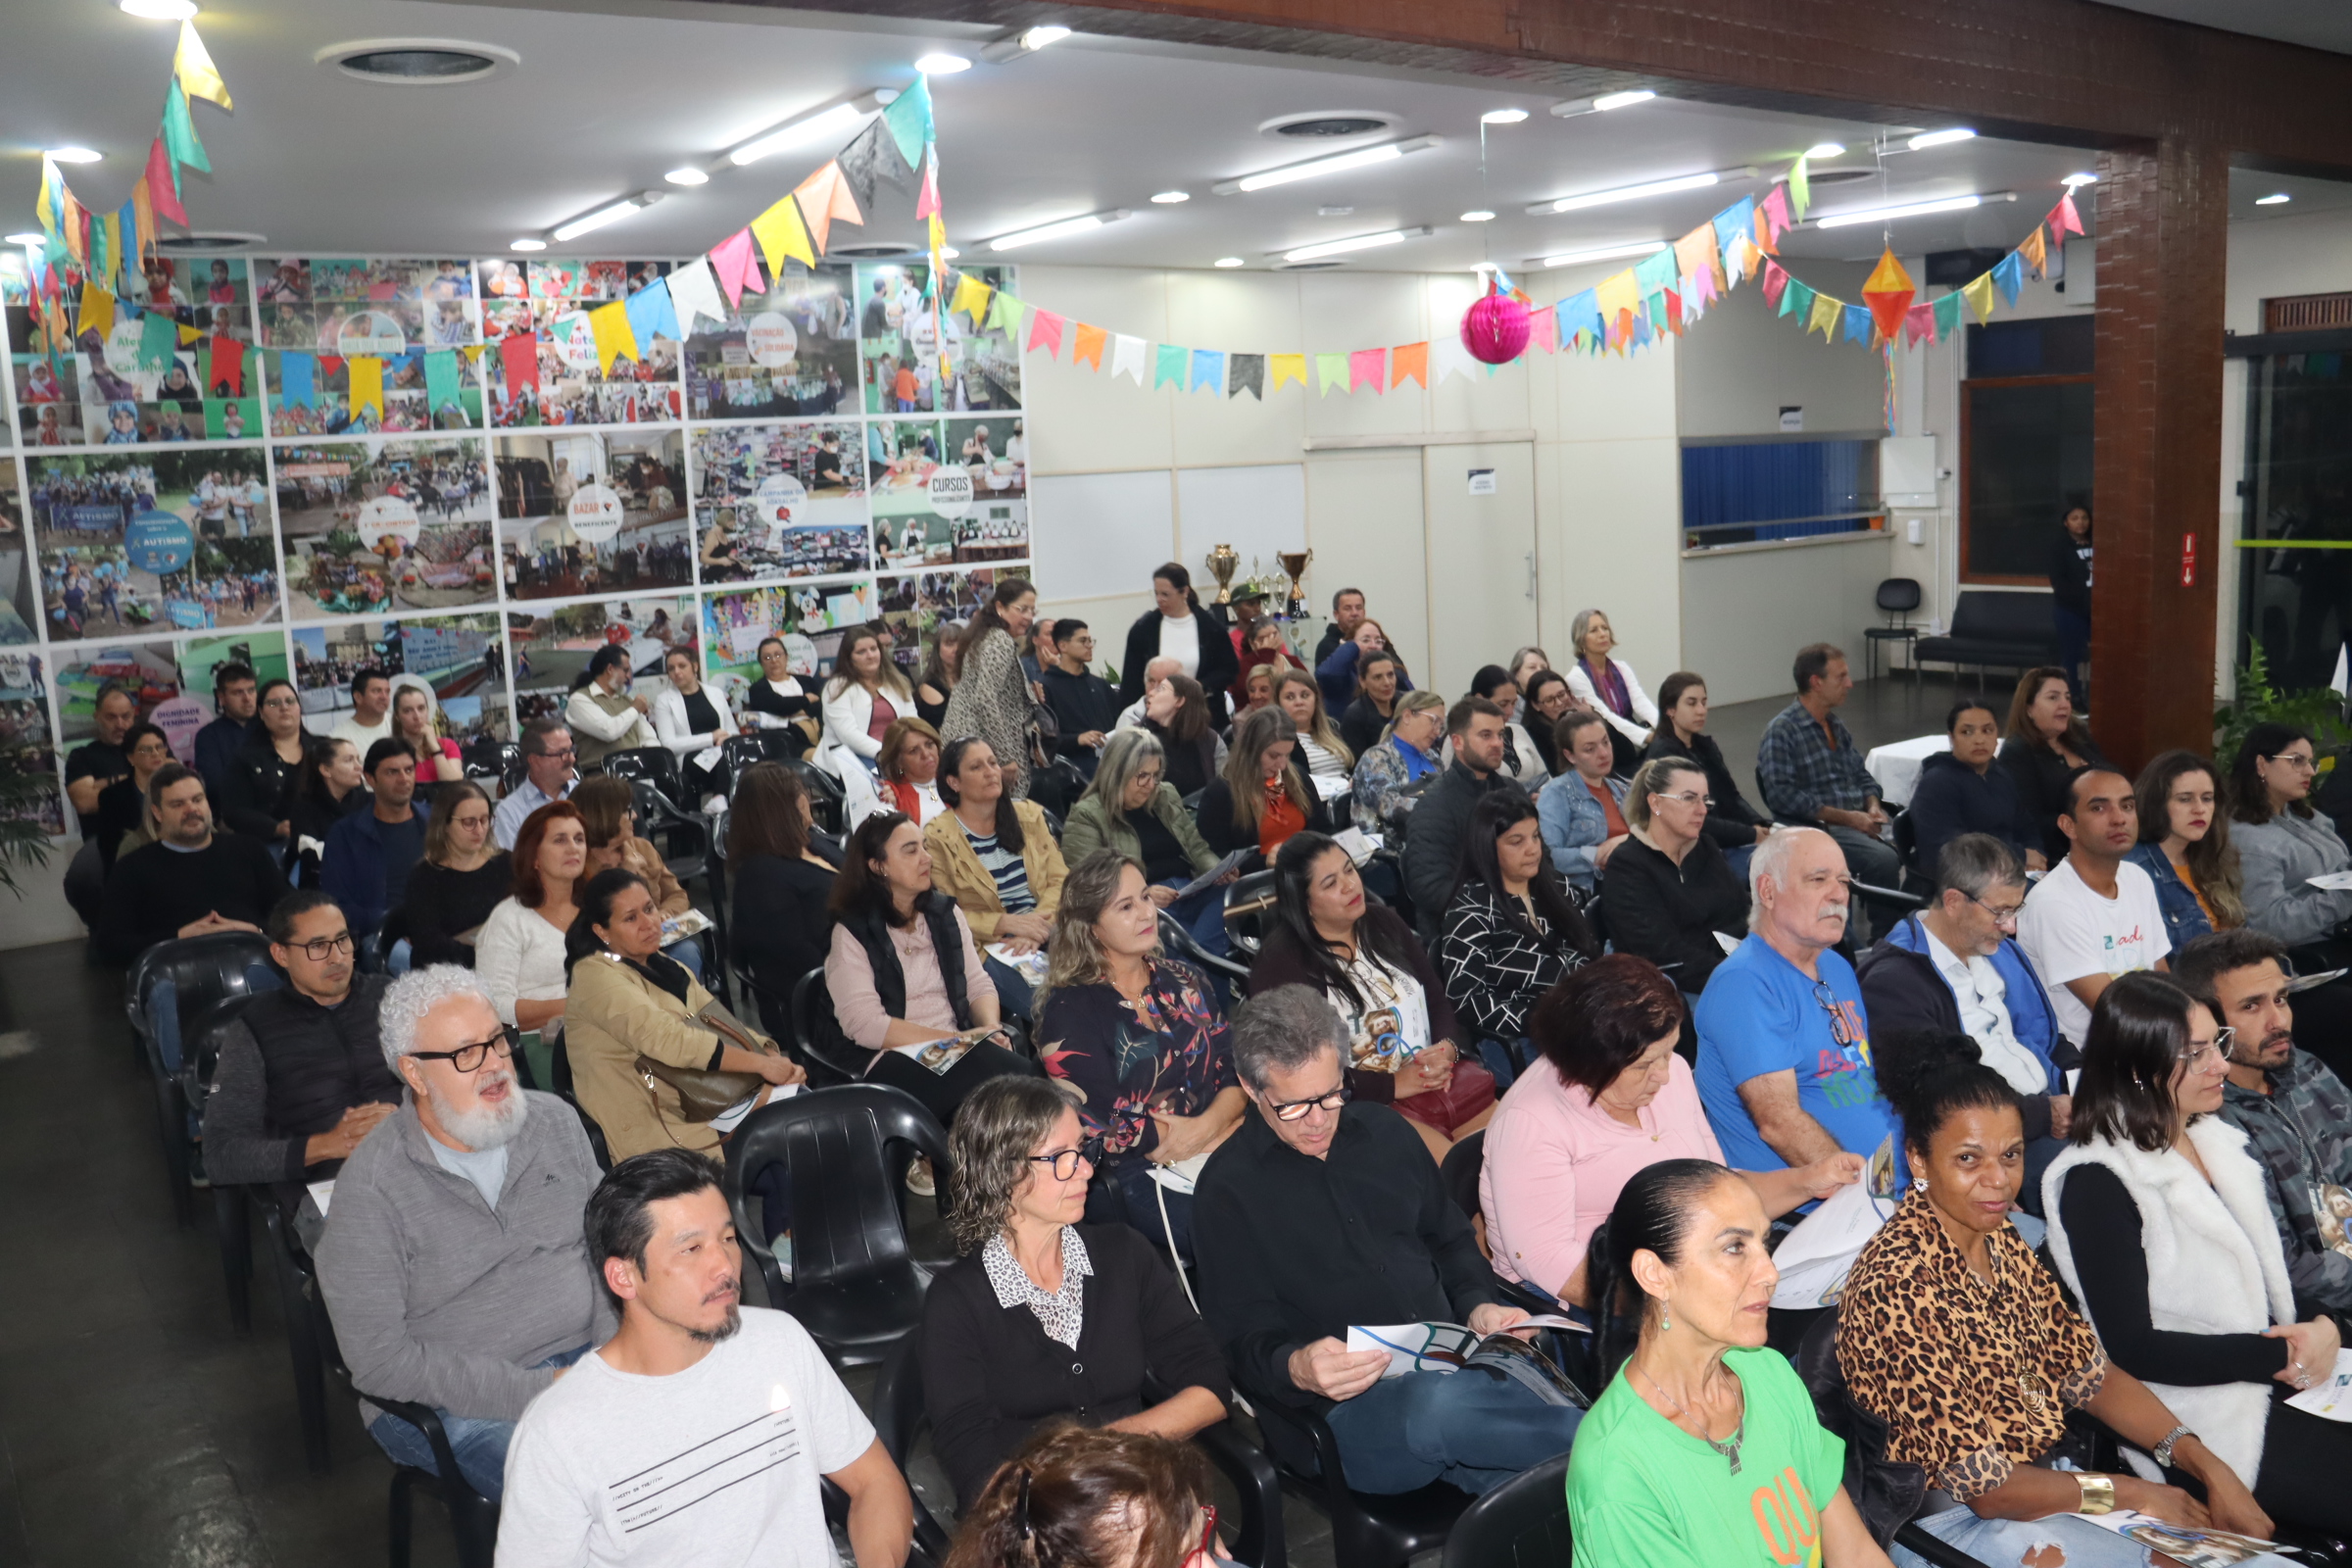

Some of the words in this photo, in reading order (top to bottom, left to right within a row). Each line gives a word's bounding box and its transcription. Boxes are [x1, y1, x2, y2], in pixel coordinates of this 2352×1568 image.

[932, 476, 968, 492] CURSOS
[573, 503, 601, 514] BAZAR
[574, 519, 617, 529] BENEFICENTE
[144, 536, 186, 547] AUTISMO
[158, 708, 201, 719] DIGNIDADE
[163, 717, 200, 727] FEMININA
